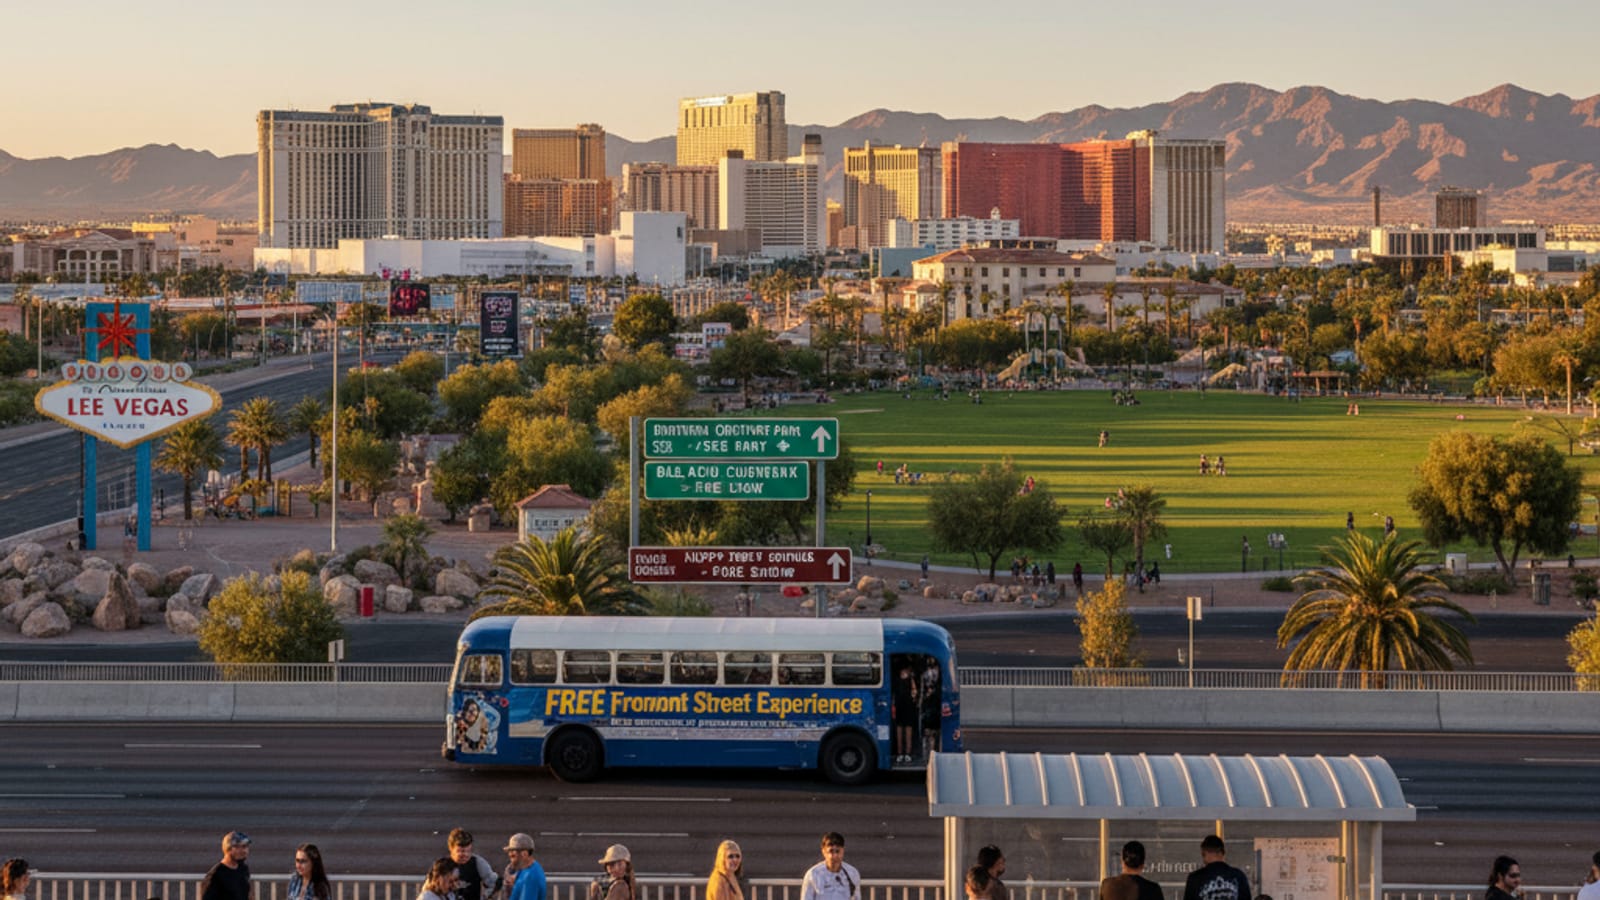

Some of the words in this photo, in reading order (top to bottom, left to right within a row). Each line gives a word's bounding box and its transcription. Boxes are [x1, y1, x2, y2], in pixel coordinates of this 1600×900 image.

[67, 398, 104, 416] LEE
[114, 398, 189, 417] VEGAS
[545, 689, 606, 716] FREE
[693, 691, 752, 714] Street
[757, 691, 863, 719] Experience
